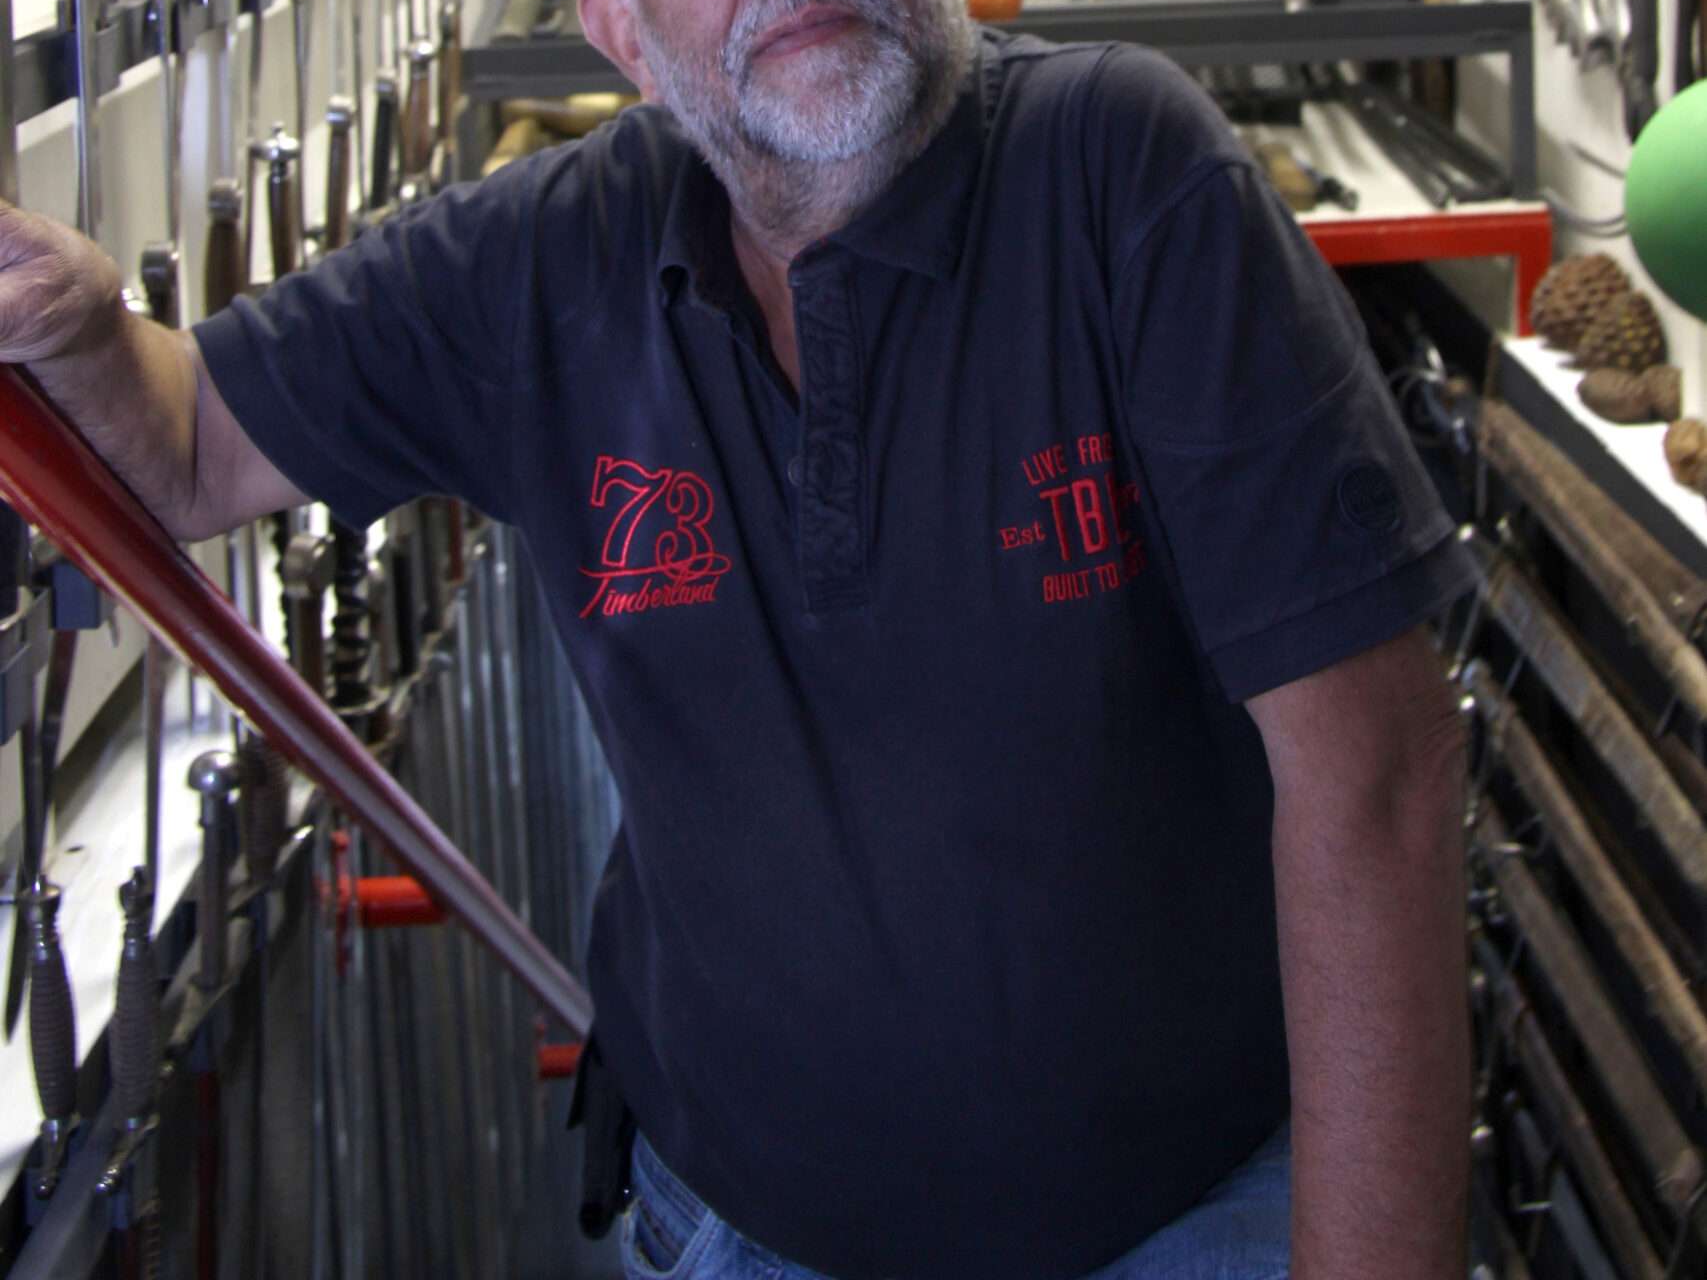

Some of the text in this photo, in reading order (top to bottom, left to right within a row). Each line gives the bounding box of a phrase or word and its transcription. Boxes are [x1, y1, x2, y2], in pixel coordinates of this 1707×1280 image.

[1021, 444, 1069, 487] LIVE
[590, 453, 715, 581] 73
[999, 521, 1047, 551] Est
[577, 552, 733, 618] Timberland
[1042, 568, 1090, 604] BUILT
[1095, 561, 1121, 592] TO
